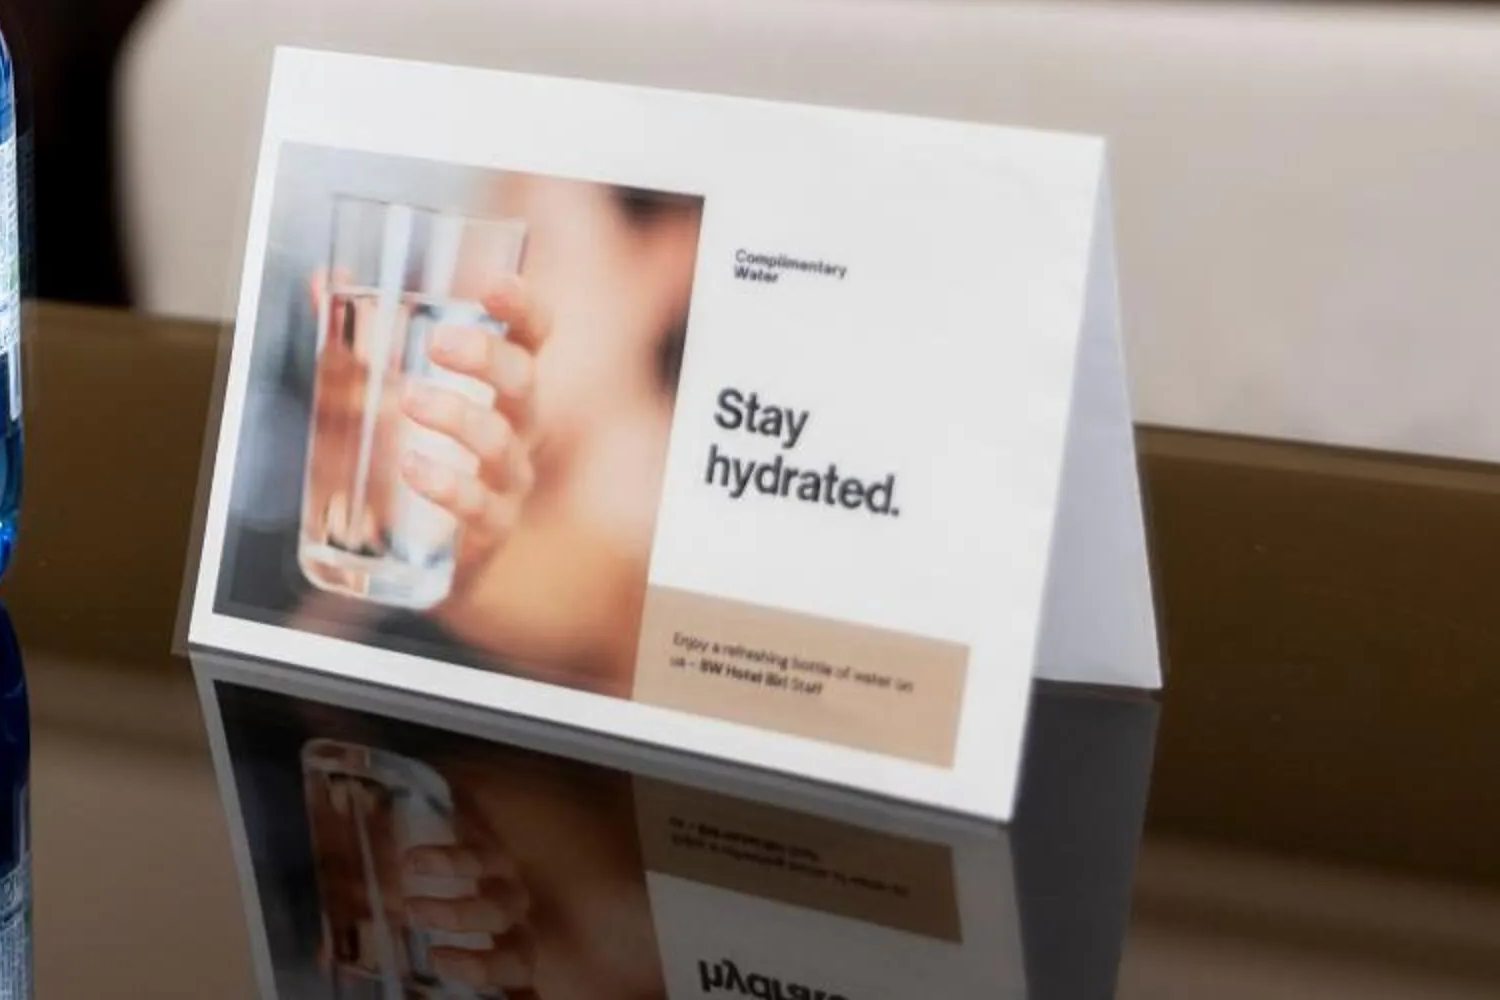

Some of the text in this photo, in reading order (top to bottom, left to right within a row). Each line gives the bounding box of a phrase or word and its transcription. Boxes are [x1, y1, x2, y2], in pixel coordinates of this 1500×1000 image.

[734, 265, 779, 284] Water
[735, 249, 847, 279] Complimentary
[714, 388, 809, 449] Stay
[705, 444, 900, 517] hydrated.
[673, 631, 709, 653] Enjoy
[722, 645, 787, 671] refreshing
[791, 656, 832, 676] bottle
[836, 665, 851, 680] of
[853, 671, 891, 688] water
[700, 658, 723, 676] BW
[725, 664, 763, 684] Hotel
